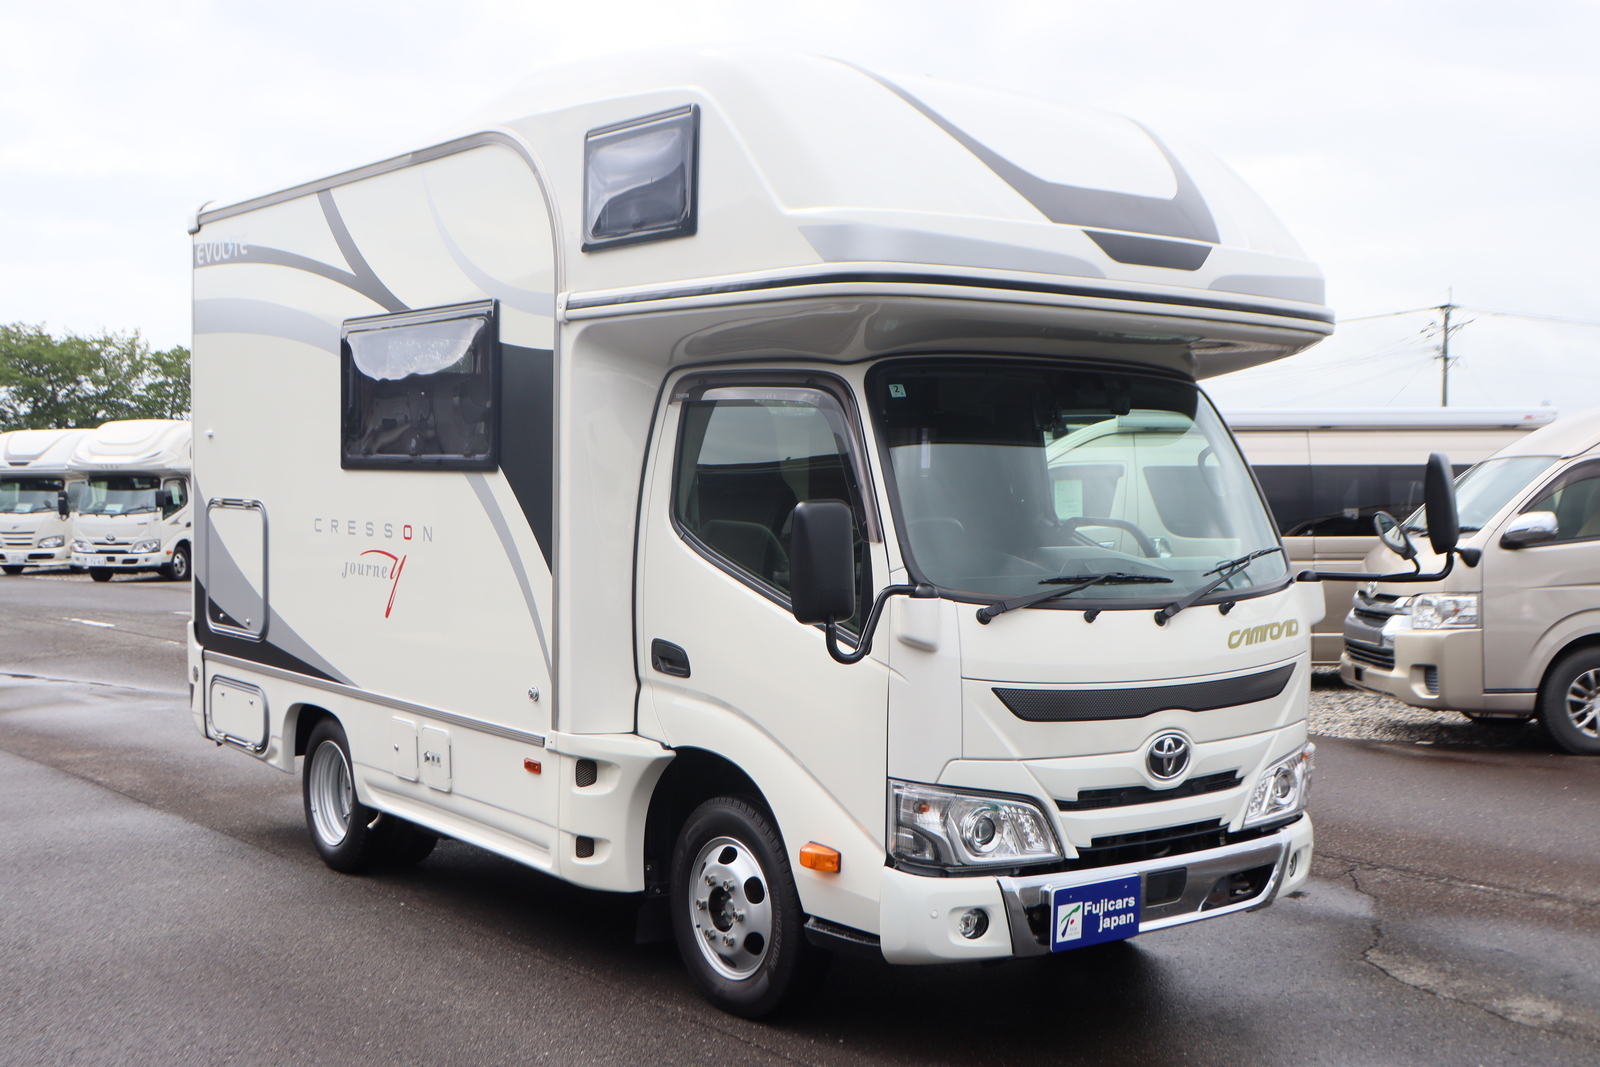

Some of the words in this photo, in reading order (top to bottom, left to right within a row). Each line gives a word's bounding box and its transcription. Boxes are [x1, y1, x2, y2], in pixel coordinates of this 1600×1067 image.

[893, 385, 901, 393] 2
[314, 518, 433, 543] CRESSON
[1083, 896, 1136, 917] Fujicars
[769, 884, 783, 973] BRIDGESTONE
[1097, 912, 1135, 933] japan
